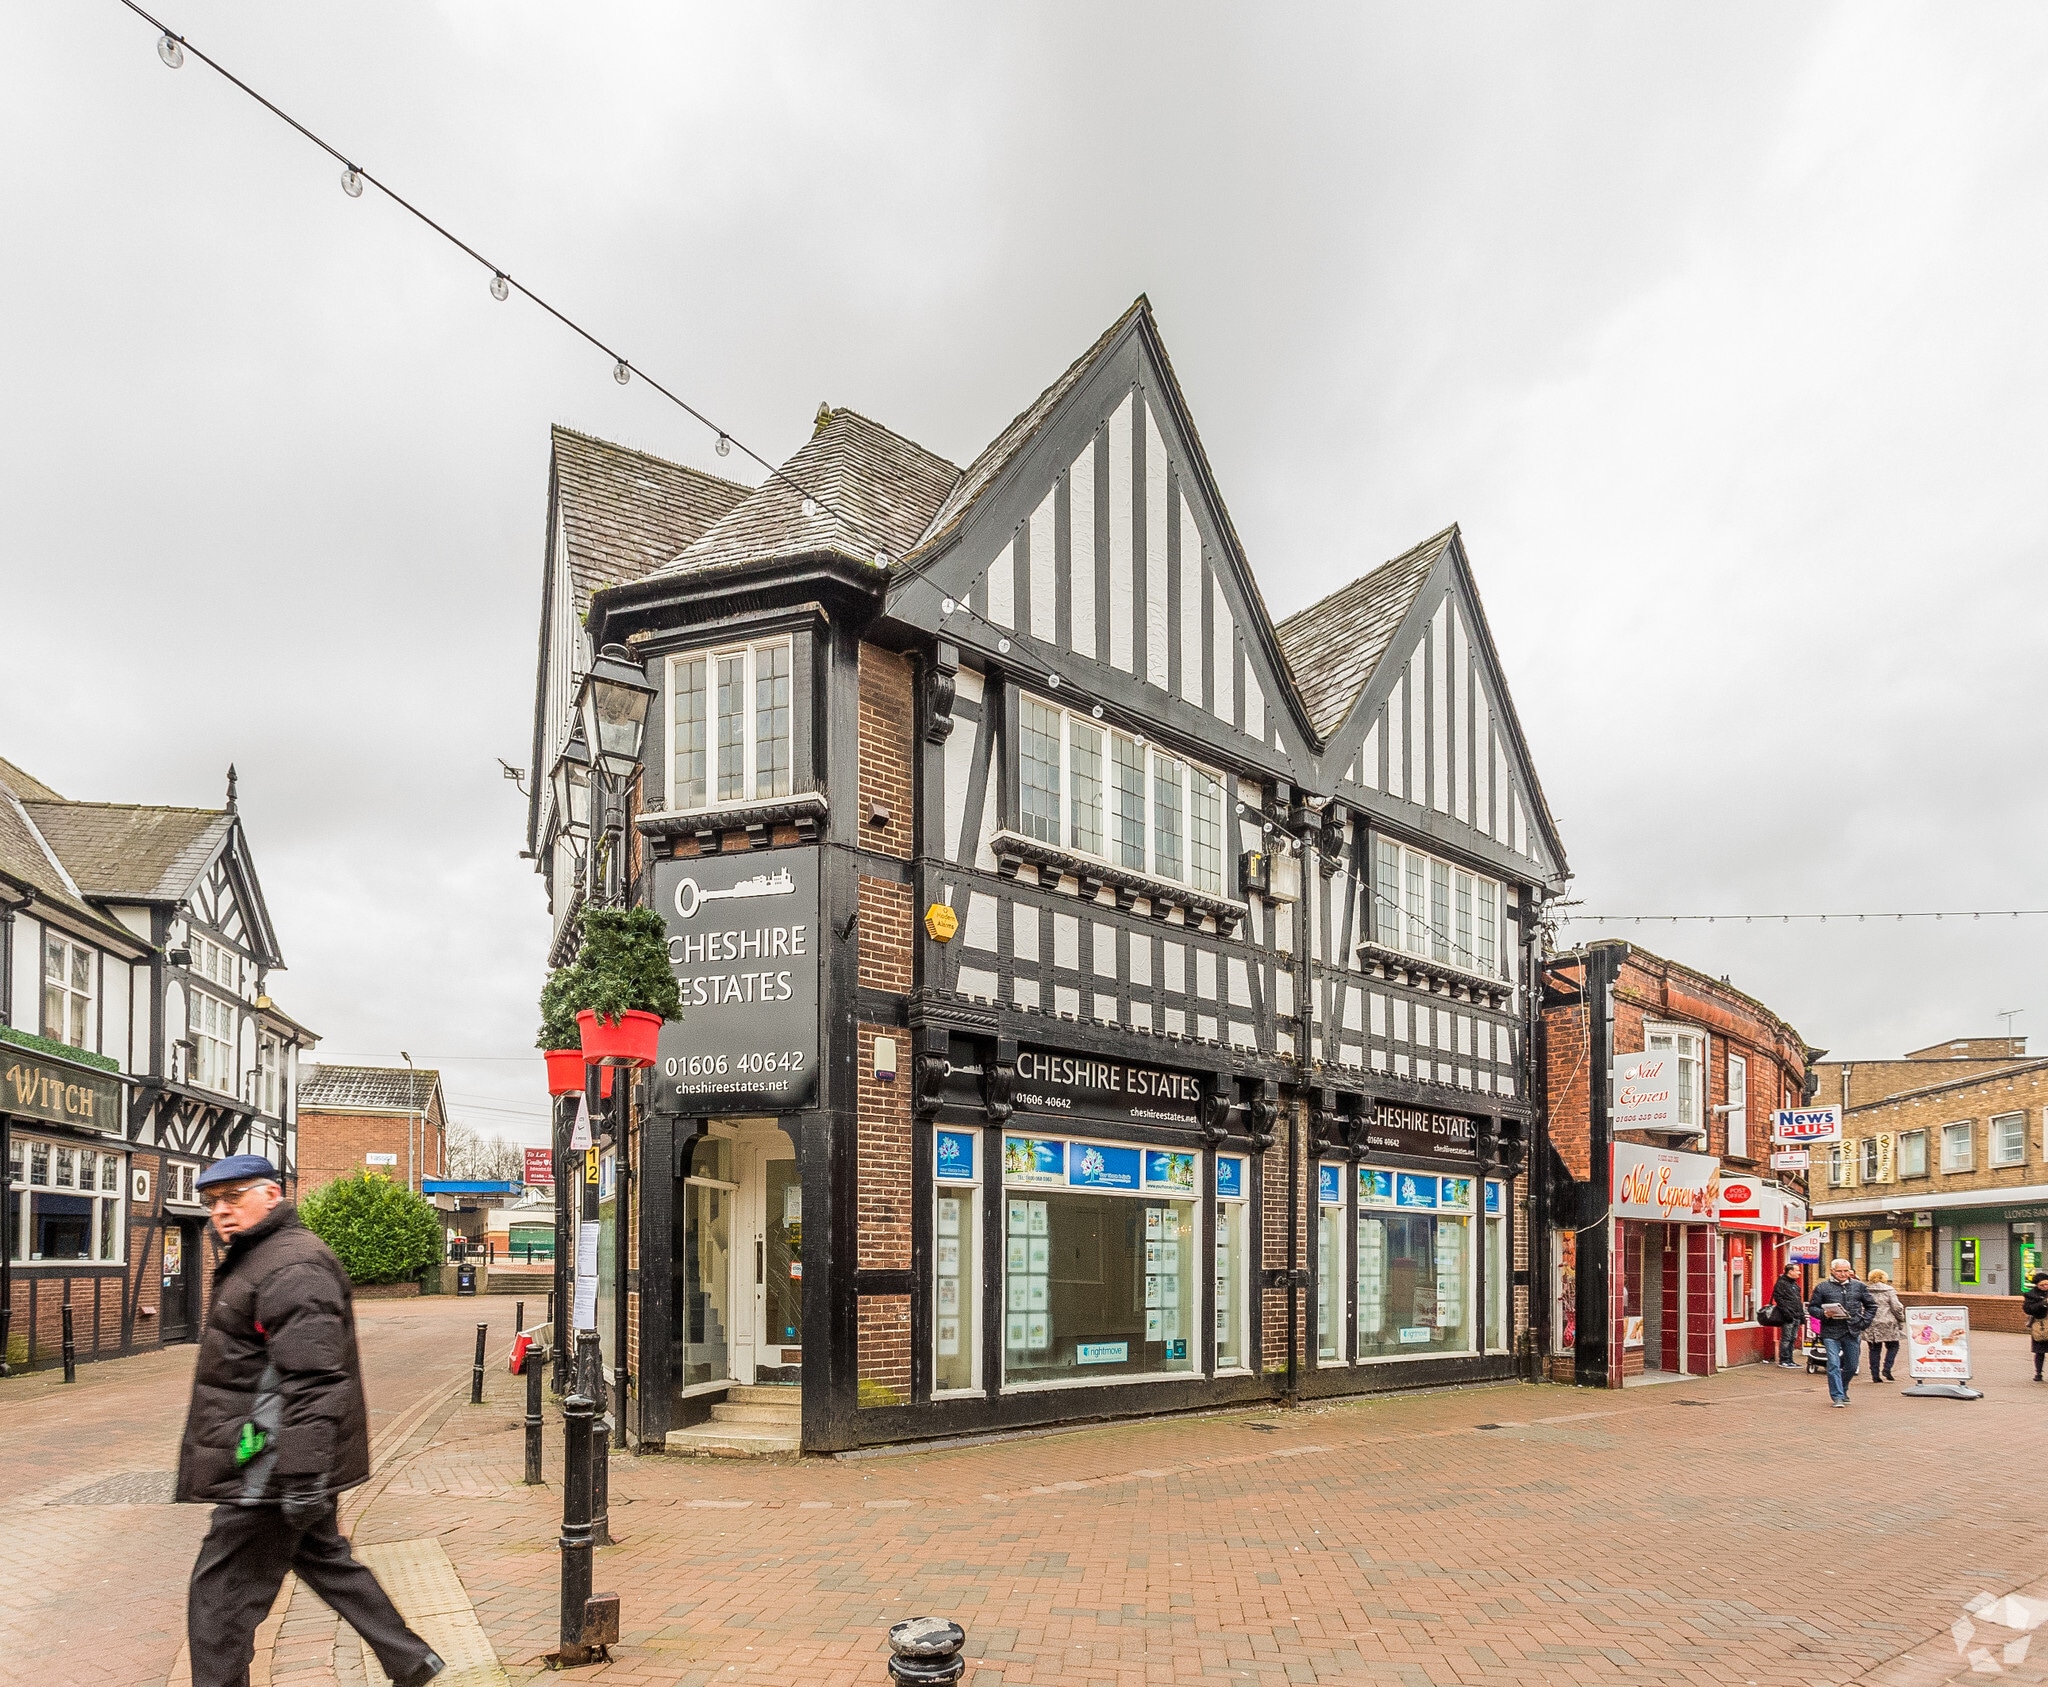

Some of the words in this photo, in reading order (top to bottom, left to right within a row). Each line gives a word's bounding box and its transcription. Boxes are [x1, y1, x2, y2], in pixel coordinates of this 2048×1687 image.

[667, 925, 806, 964] CHESHIRE
[678, 970, 793, 1006] ESTATES
[665, 1054, 729, 1077] 01606
[737, 1051, 804, 1074] 40642
[1625, 1060, 1664, 1080] Nail
[676, 1080, 788, 1094] cheshireestates.net
[1016, 1052, 1120, 1091] CHESHIRE
[1126, 1068, 1200, 1102] ESTATES
[1016, 1092, 1043, 1106] 01606
[1045, 1096, 1071, 1109] 40642
[1620, 1086, 1669, 1109] Express
[1130, 1107, 1197, 1124] cheshireestates.net
[1780, 1112, 1834, 1126] News
[1432, 1114, 1477, 1138] ESTATES
[1780, 1124, 1832, 1136] PLUS
[1621, 1163, 1654, 1204] Nail
[1091, 1346, 1122, 1358] rightmove
[1927, 1346, 1953, 1358] Open
